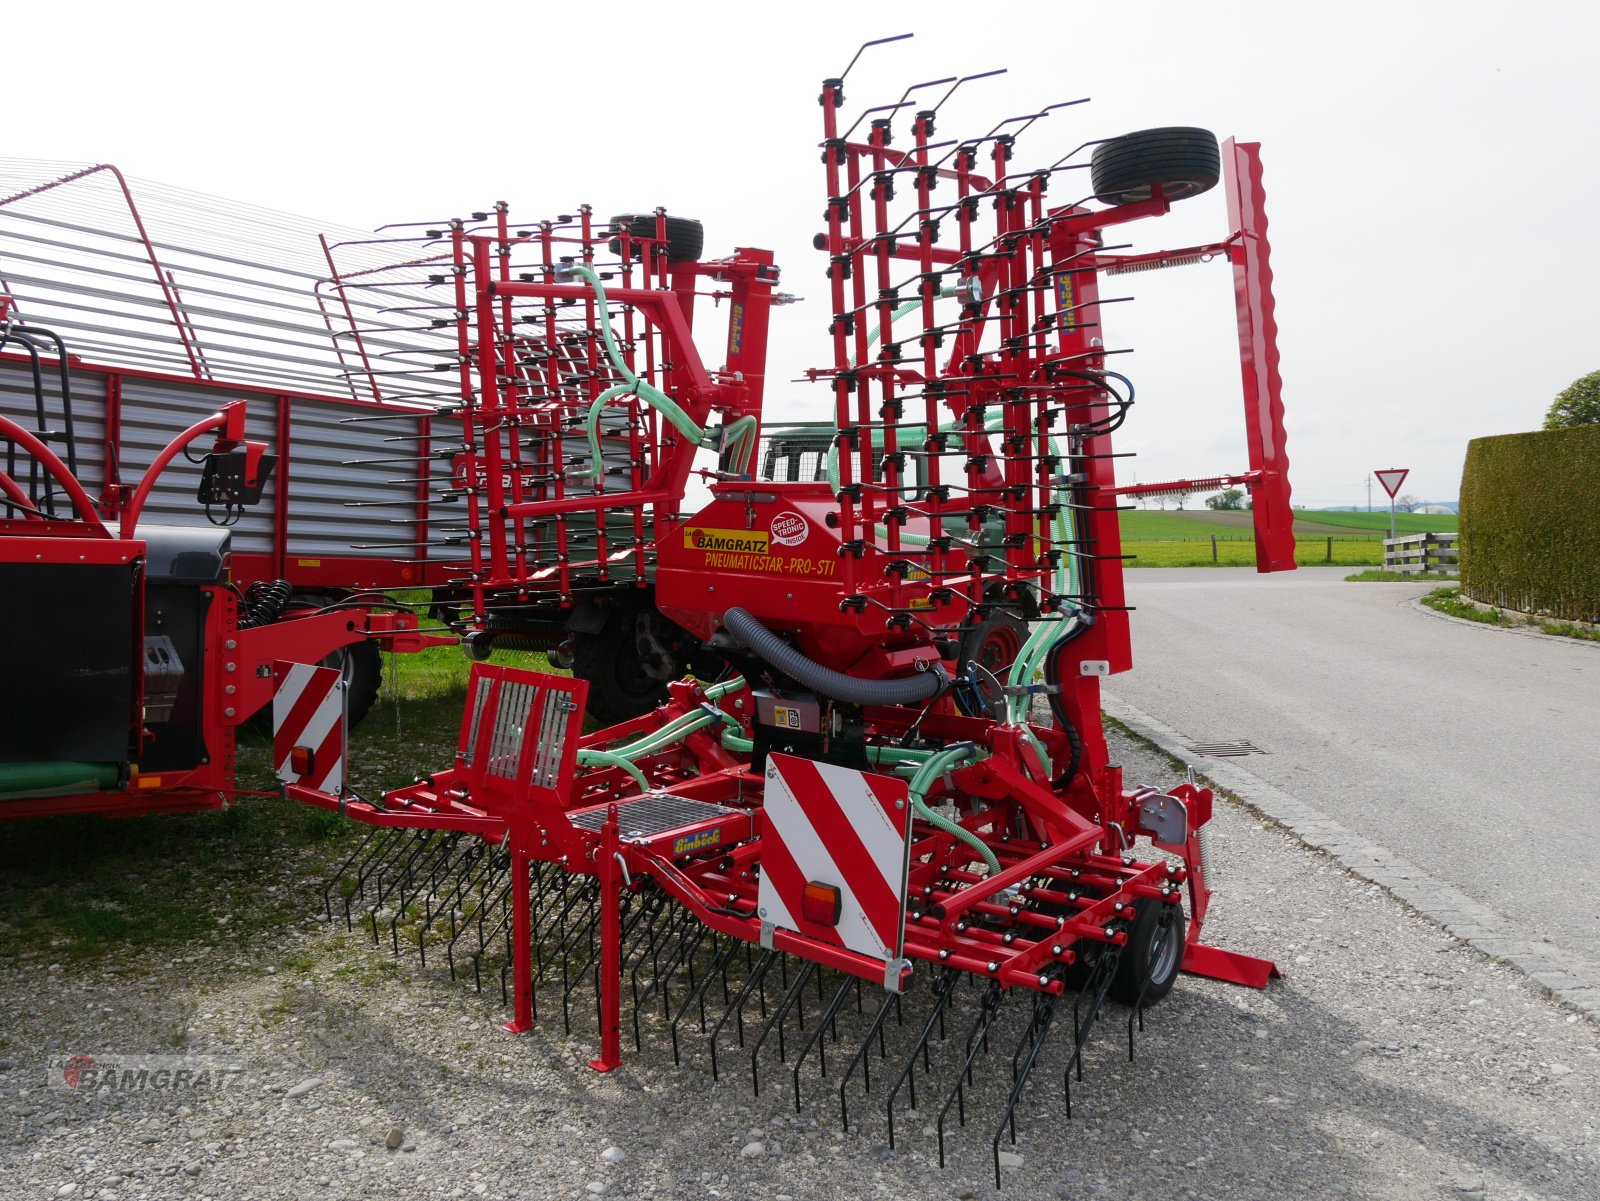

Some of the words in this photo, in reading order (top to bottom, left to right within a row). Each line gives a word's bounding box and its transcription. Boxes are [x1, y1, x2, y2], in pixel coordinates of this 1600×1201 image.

[772, 518, 798, 531] SPEED-
[778, 523, 804, 536] TRONIC
[697, 537, 767, 552] BAMGRATZ
[786, 534, 805, 544] INSIDE
[705, 552, 835, 576] PNEUMATICSTAR-PRO-STI
[675, 829, 720, 853] Einböck
